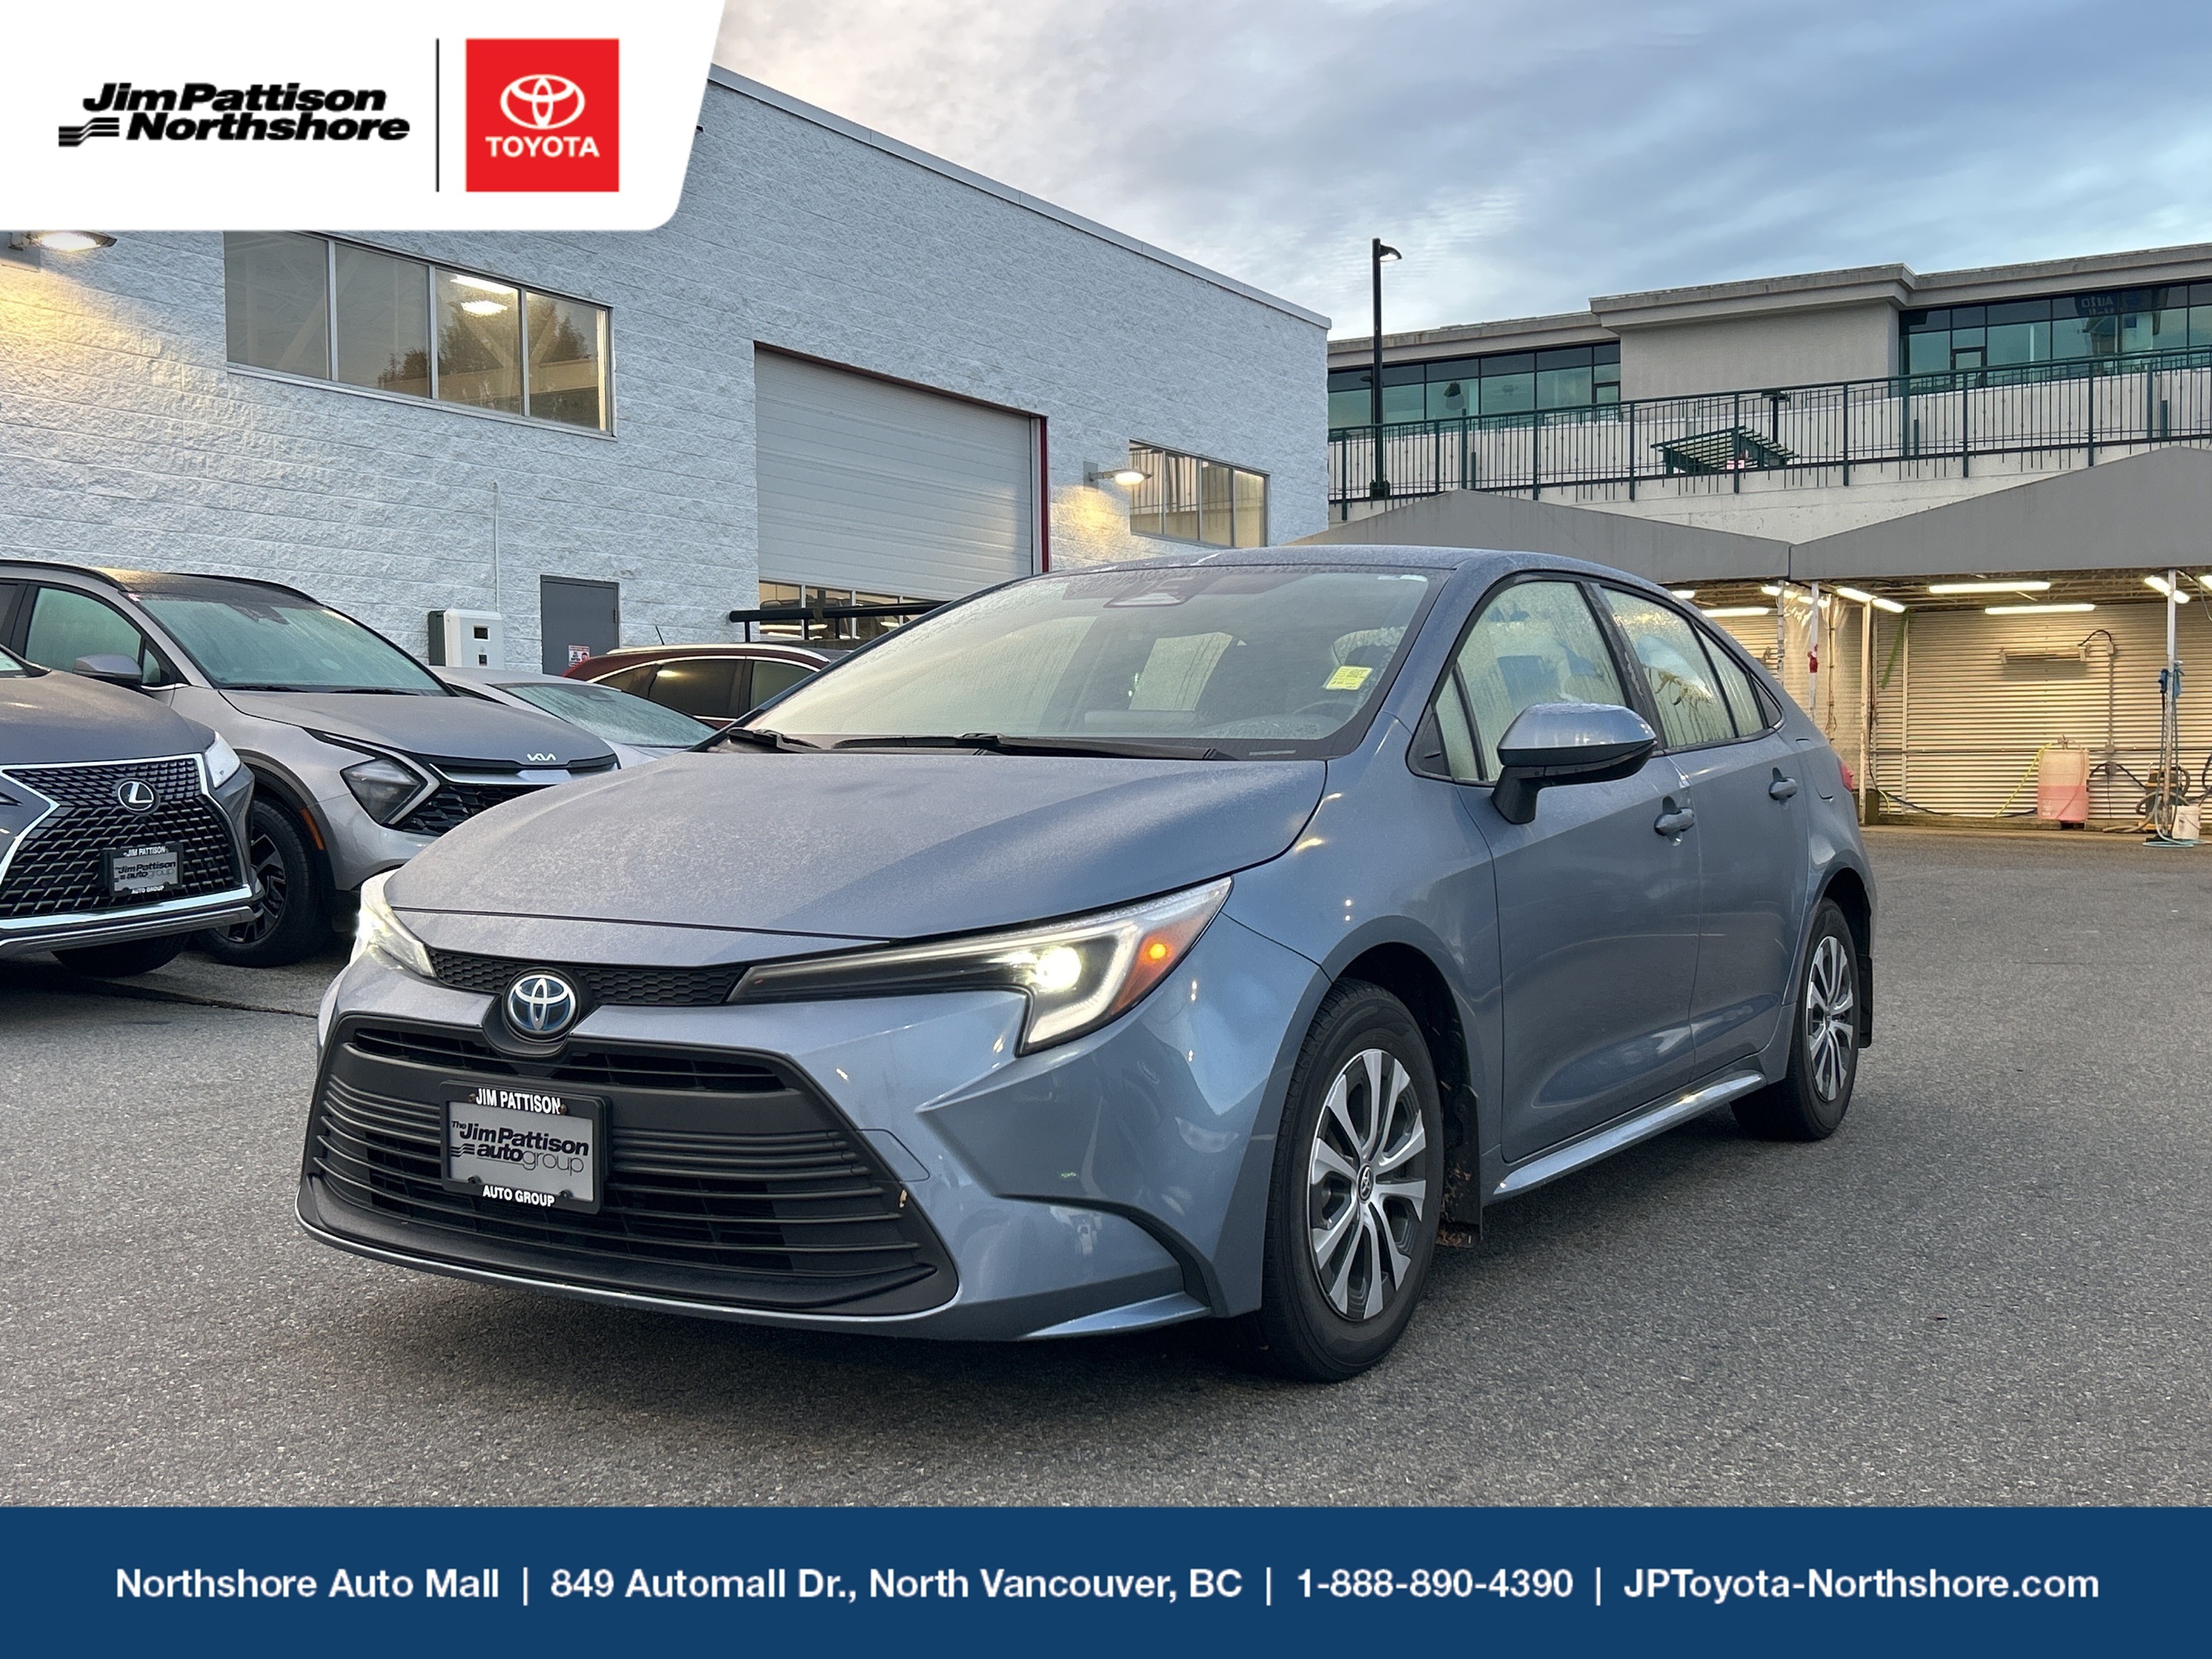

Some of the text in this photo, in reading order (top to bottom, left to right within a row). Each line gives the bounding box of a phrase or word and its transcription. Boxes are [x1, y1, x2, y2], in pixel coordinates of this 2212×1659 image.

[126, 846, 166, 857] JIM PATTISON
[475, 1088, 561, 1114] JIM PATTISON
[452, 1121, 590, 1157] The Jim Pattison
[482, 1184, 555, 1207] AUTO GROUP
